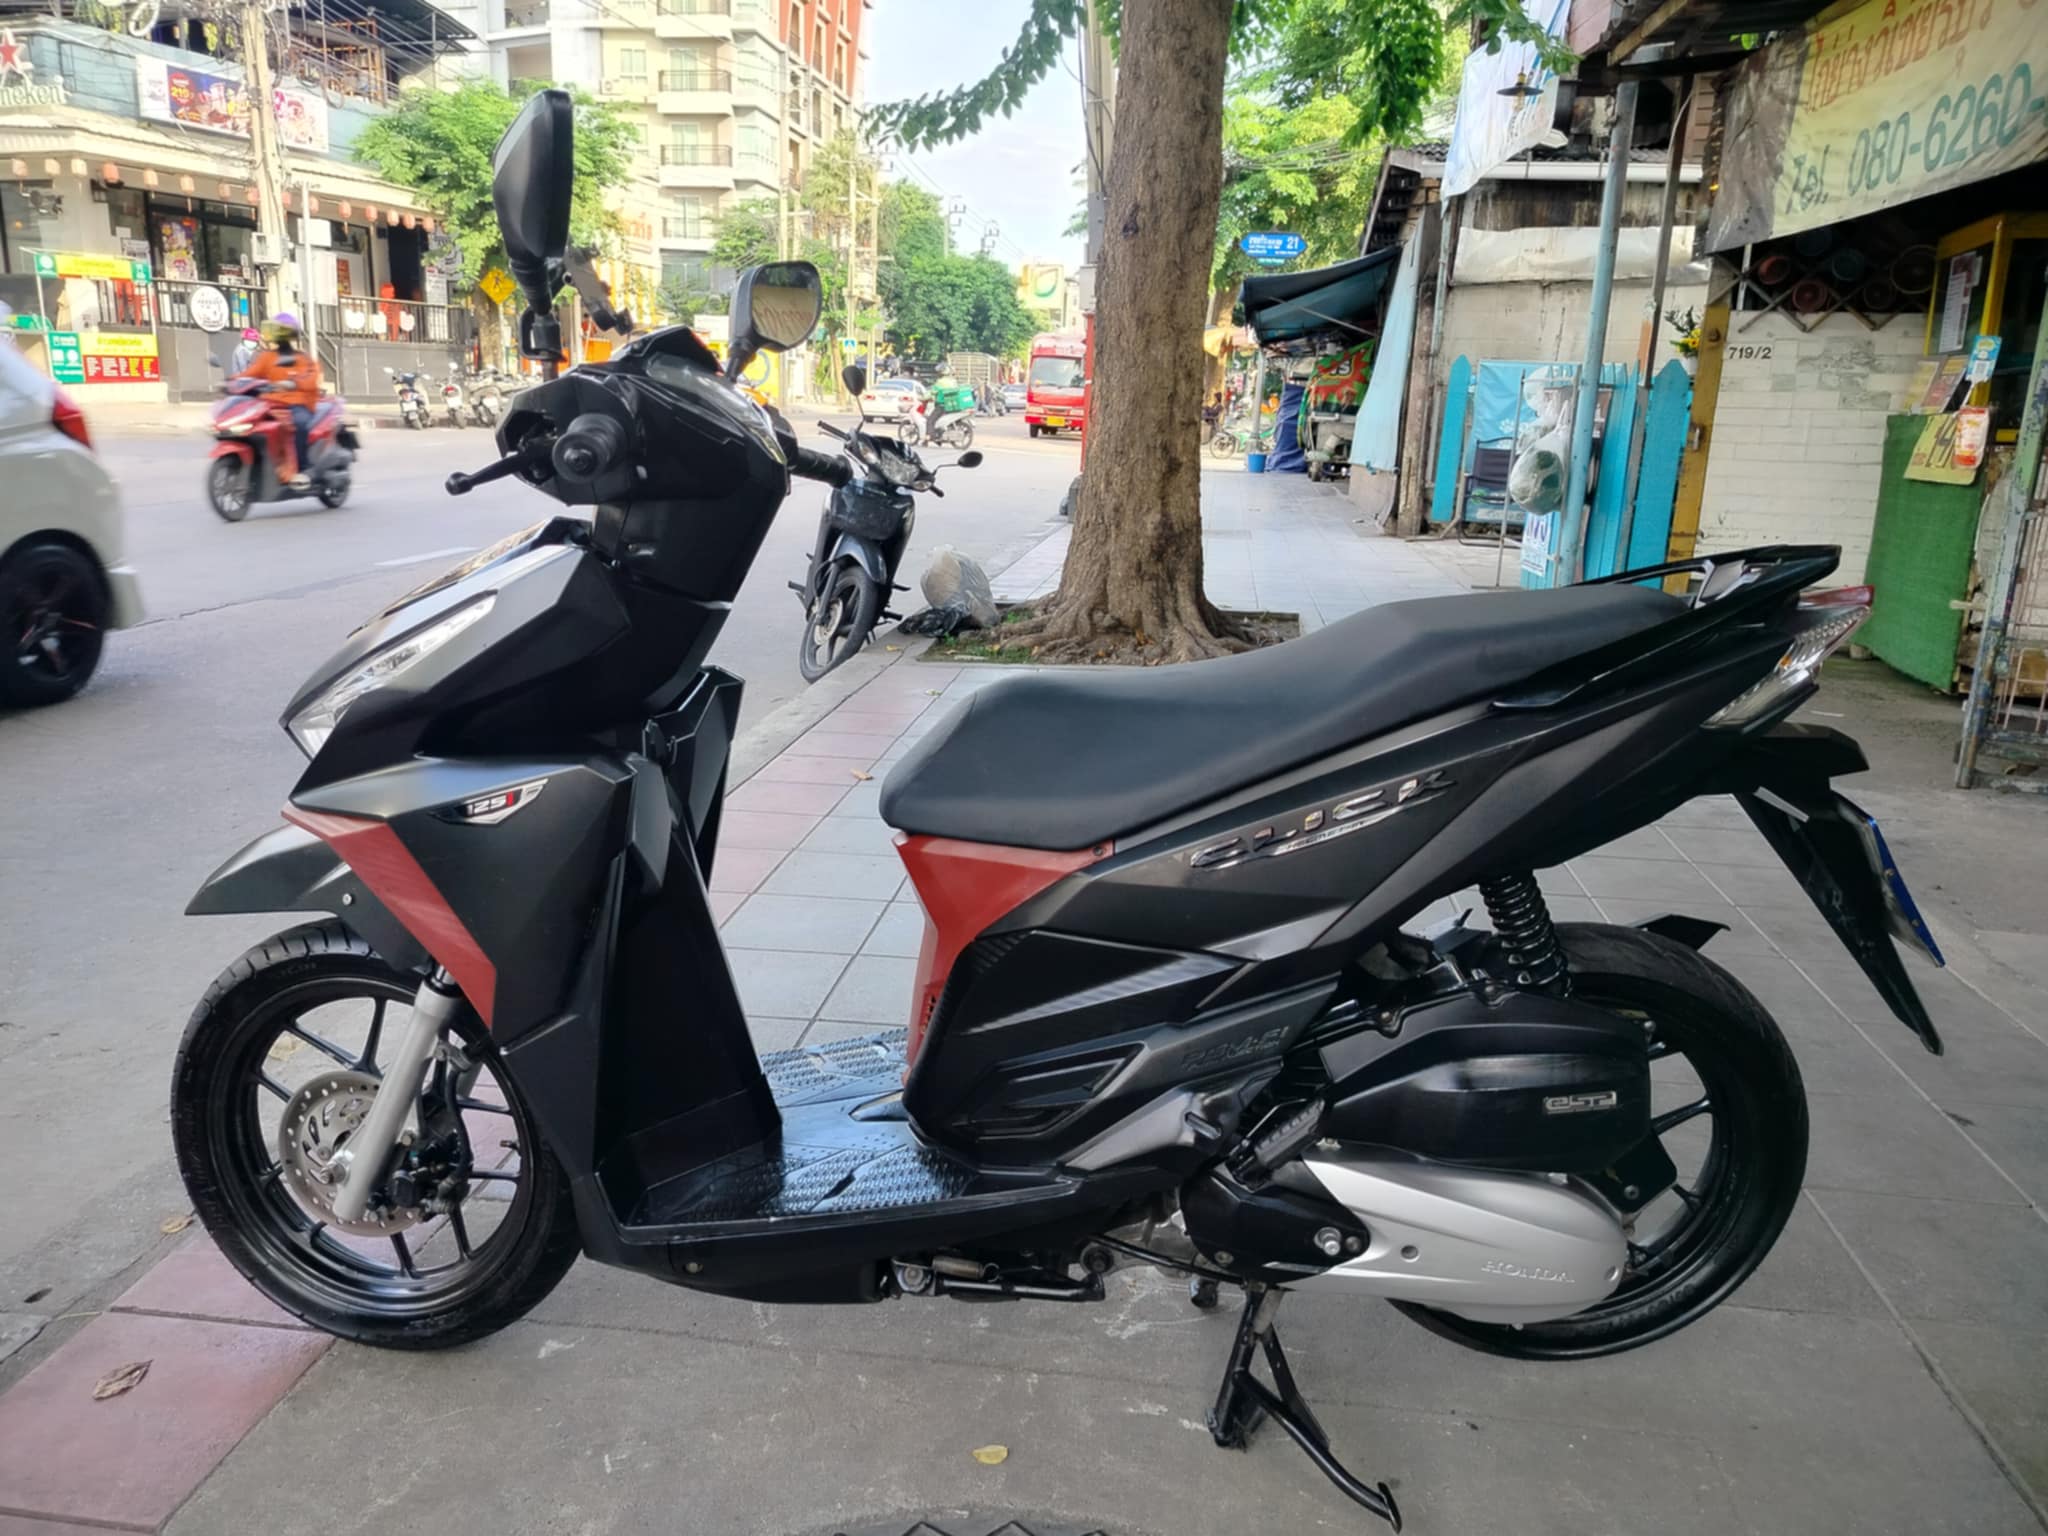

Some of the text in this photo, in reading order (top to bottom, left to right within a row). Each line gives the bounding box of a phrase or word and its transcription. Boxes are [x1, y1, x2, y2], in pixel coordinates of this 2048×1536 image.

[1847, 62, 2048, 198] 080-6260-
[1728, 346, 1772, 360] 719/2
[1481, 1260, 1576, 1284] HONDA
